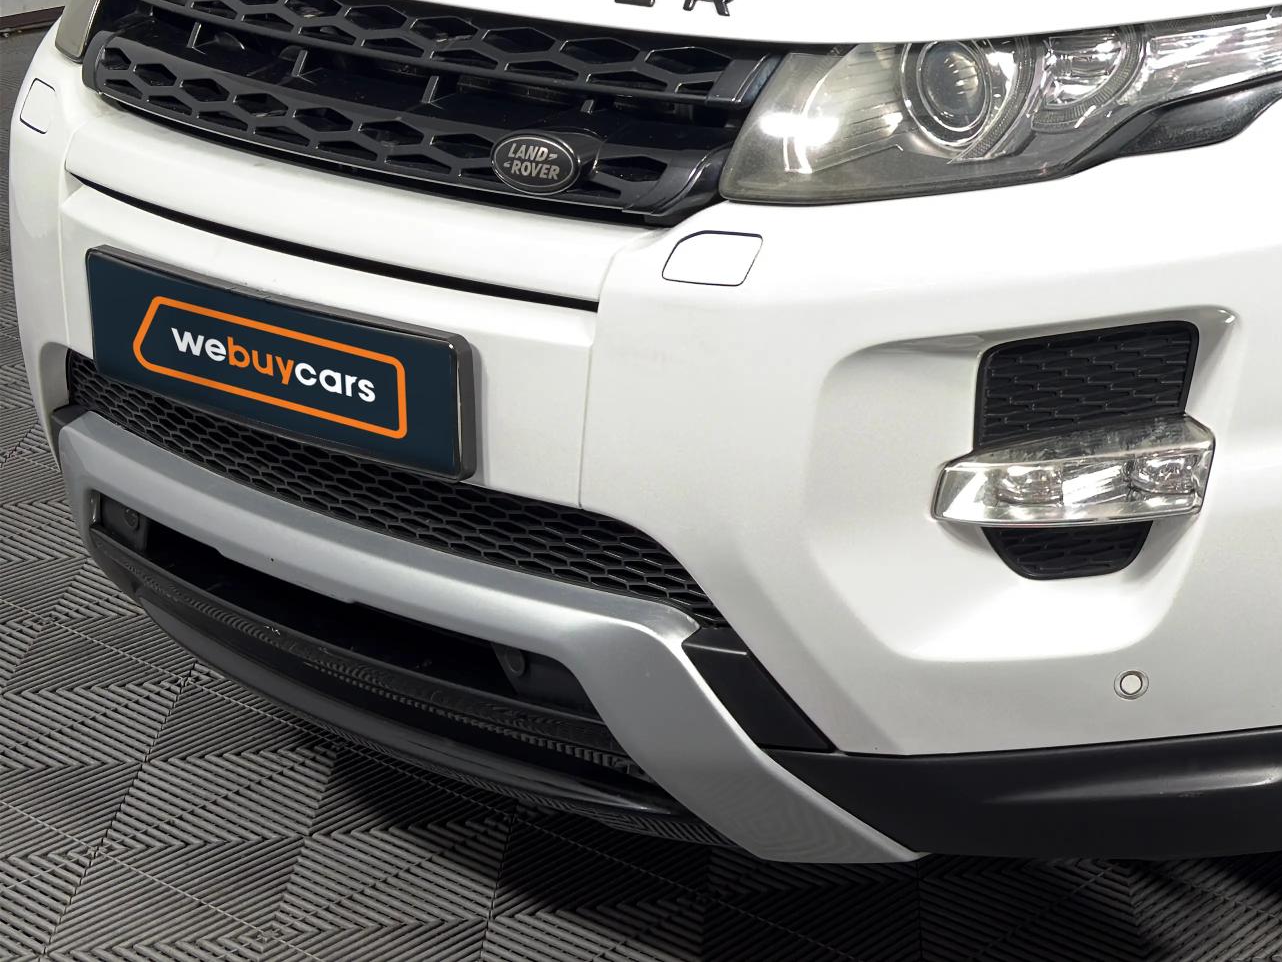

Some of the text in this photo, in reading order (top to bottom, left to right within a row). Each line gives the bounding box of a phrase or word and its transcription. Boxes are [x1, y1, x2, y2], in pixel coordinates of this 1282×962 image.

[508, 143, 548, 162] LAND
[511, 160, 560, 180] ROVER
[170, 327, 376, 403] webuycars
